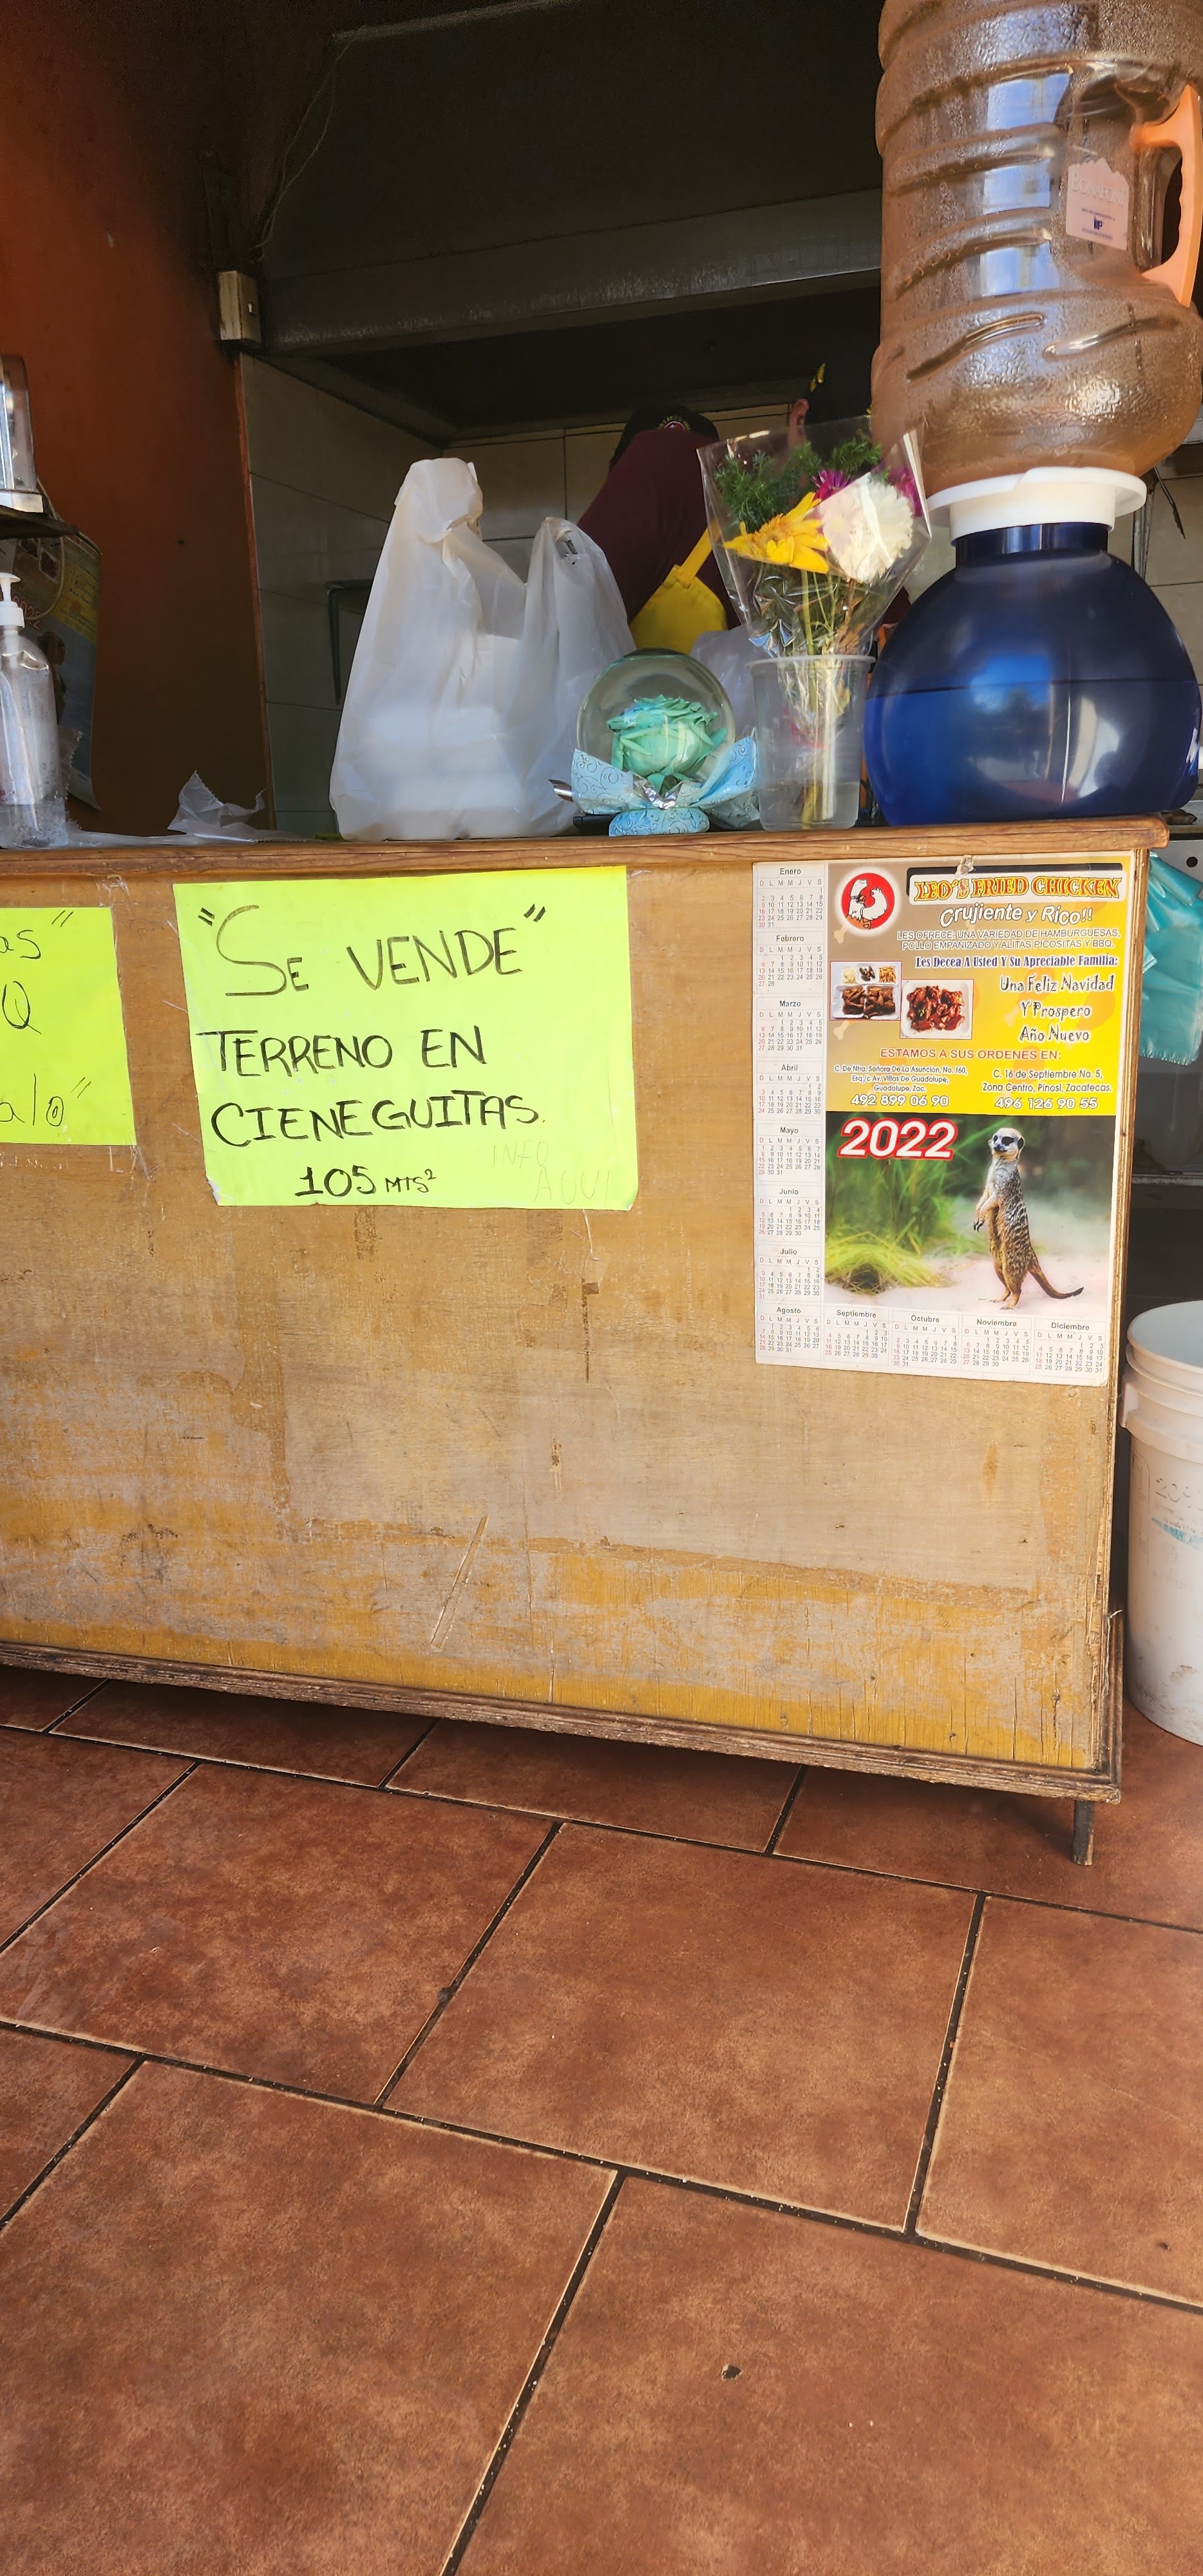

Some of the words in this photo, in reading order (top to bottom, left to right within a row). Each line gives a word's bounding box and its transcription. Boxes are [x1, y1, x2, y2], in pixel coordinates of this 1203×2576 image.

[1071, 173, 1126, 207] BONAFONT
[971, 876, 1028, 898] FRIED
[1032, 875, 1122, 898] CHICKEN
[939, 903, 1023, 927] Crujiente
[1025, 911, 1037, 922] y
[1041, 905, 1093, 925] Rico!!
[897, 931, 914, 940] LES
[957, 931, 977, 939] UNA
[978, 930, 1023, 938] VARIEDAD
[1025, 929, 1038, 938] DE
[1040, 929, 1121, 938] HAMBURGUESAS,
[903, 942, 932, 950] POLLO
[933, 941, 991, 950] EMPANIZADO
[1001, 940, 1032, 949] ALITAS
[1034, 940, 1082, 948] PICOSITAS
[1092, 939, 1114, 948] BBQ.
[916, 957, 931, 967] Les
[933, 957, 961, 967] Decea
[964, 957, 971, 967] A
[972, 957, 998, 967] Usted
[1001, 956, 1007, 967] Y
[1009, 956, 1021, 967] Su
[1023, 956, 1075, 969] Apreciable
[1000, 975, 1024, 992] Una
[1027, 974, 1058, 992] Feliz
[1061, 974, 1114, 991] Navidad
[1019, 1000, 1030, 1017] Y
[1032, 1001, 1091, 1021] Prospero
[1019, 1025, 1045, 1041] Año
[1048, 1025, 1090, 1042] Nuevo
[196, 1030, 393, 1077] TERRENO
[420, 1025, 488, 1069] EN
[880, 1048, 936, 1058] ESTAMOS
[939, 1050, 947, 1058] A
[950, 1050, 974, 1059] SUS
[978, 1050, 1037, 1059] ORDENES
[1041, 1050, 1061, 1059] EN:
[911, 1075, 949, 1084] Guadalupe,
[993, 1070, 1002, 1078] C.
[1005, 1070, 1013, 1078] 16
[1016, 1070, 1027, 1078] de
[1028, 1070, 1077, 1079] Septiembre
[1079, 1070, 1093, 1078] No.
[1095, 1070, 1103, 1079] 5,
[874, 1084, 911, 1093] Guadalupe,
[1005, 1083, 1036, 1093] Centro,
[851, 1094, 876, 1105] 492
[880, 1095, 907, 1106] 899
[910, 1095, 927, 1106] 06
[931, 1095, 949, 1106] 90
[994, 1097, 1023, 1108] 496
[1028, 1098, 1054, 1109] 126
[1057, 1098, 1075, 1109] 90
[1079, 1098, 1099, 1109] 55
[837, 1117, 958, 1161] 2022
[493, 1139, 548, 1169] INFO
[294, 1164, 377, 1197] 105
[837, 1310, 876, 1318] Septiembre
[1051, 1322, 1090, 1331] Diciembre
